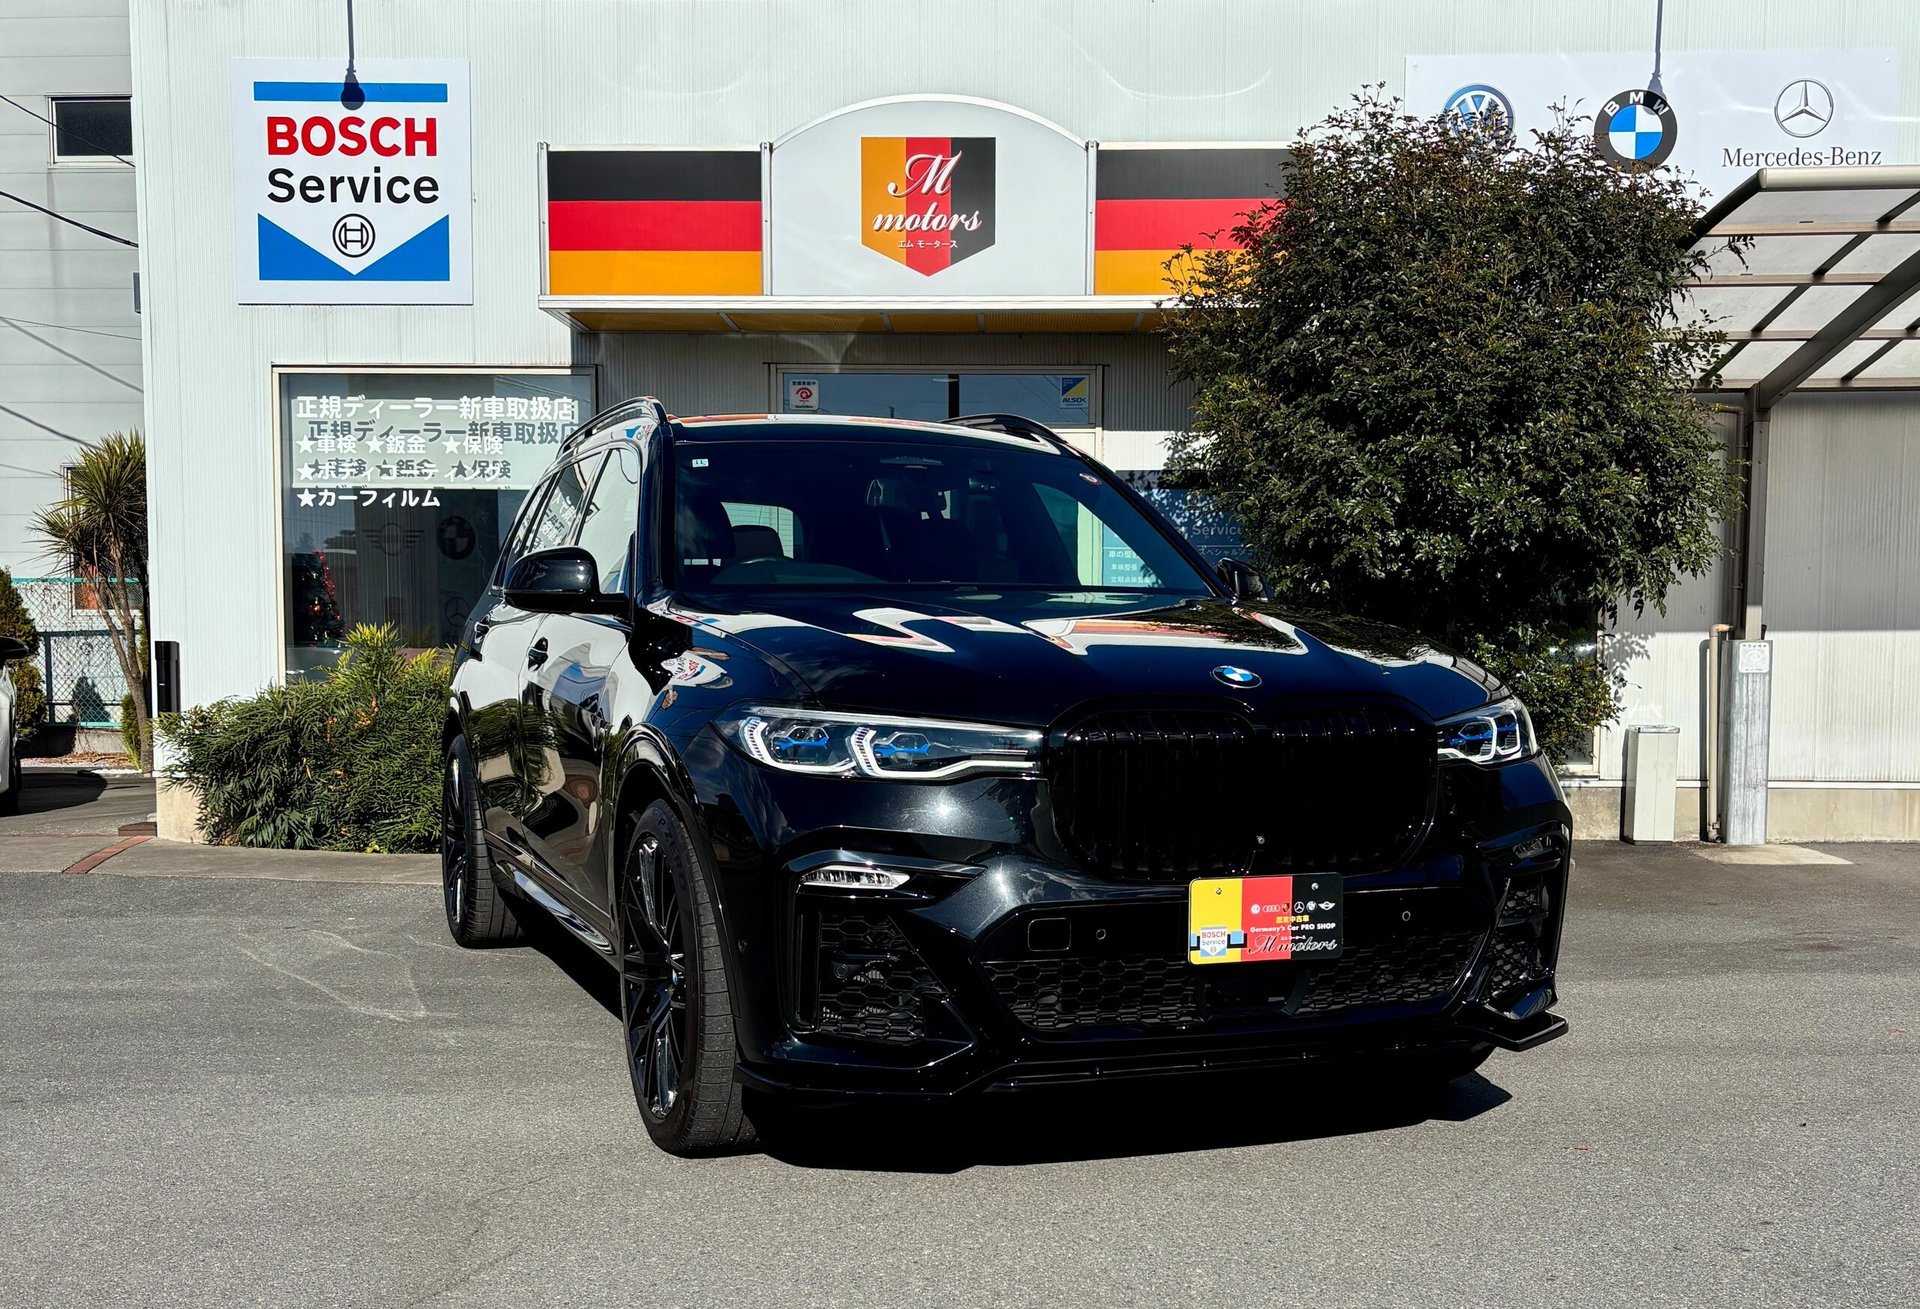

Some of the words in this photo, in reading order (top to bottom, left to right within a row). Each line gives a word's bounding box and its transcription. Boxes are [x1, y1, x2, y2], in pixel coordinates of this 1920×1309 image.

[267, 116, 437, 157] BOSCH
[1722, 146, 1882, 167] Mercedes-Benz
[887, 150, 962, 198] M
[267, 166, 439, 204] Service
[872, 201, 983, 233] motors
[898, 240, 914, 249] エム
[917, 240, 958, 249] モータース
[296, 394, 574, 421] 正規ディーラー新車取扱店
[317, 435, 357, 454] 車検
[386, 435, 426, 455] 鈑金
[462, 435, 504, 455] 保険
[318, 489, 441, 508] カーフィルム
[1201, 931, 1226, 939] BOSCH
[1317, 922, 1336, 930] SHOP
[1278, 936, 1338, 952] motors
